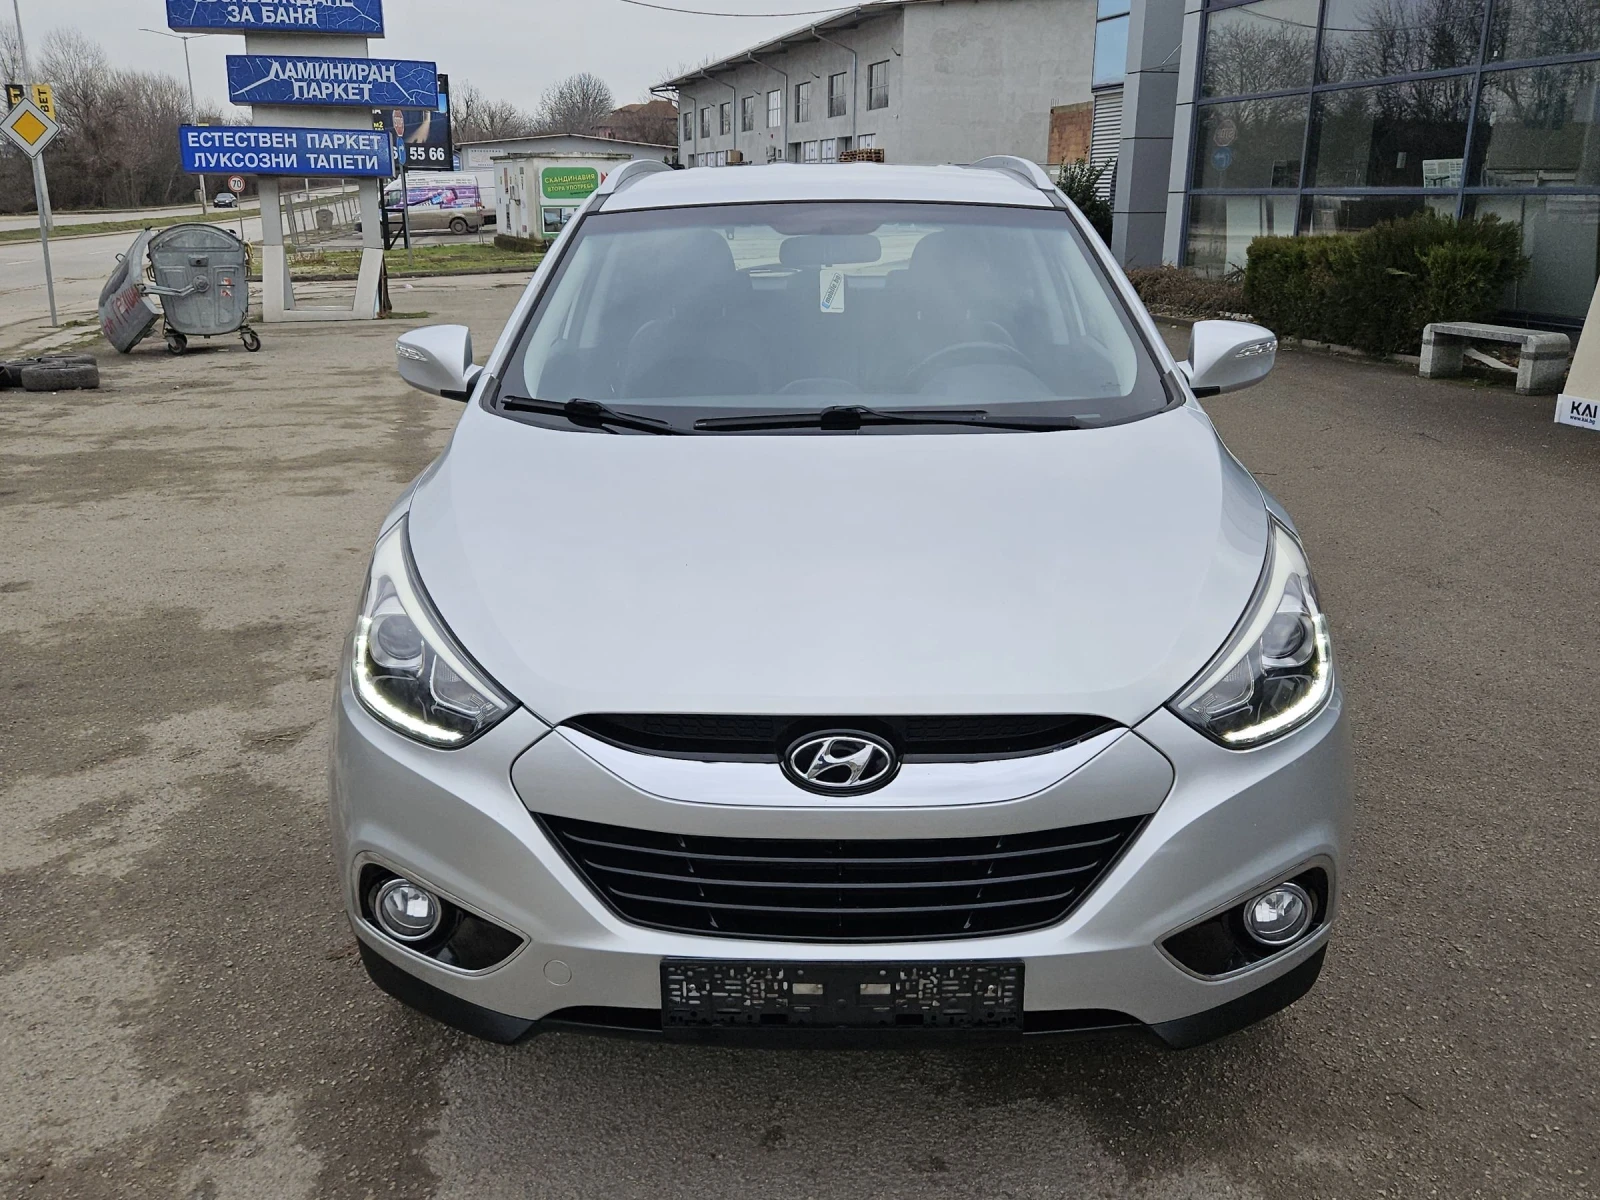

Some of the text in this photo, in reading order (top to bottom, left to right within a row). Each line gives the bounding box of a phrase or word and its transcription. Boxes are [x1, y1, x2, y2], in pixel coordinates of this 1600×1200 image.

[228, 6, 317, 24] ЗА БАНЯ
[271, 62, 396, 82] ЛАМИНИРАН
[294, 82, 373, 100] ПАРКЕТ
[187, 132, 382, 150] ЕСТЕСТВЕН ПАРКЕТ
[194, 153, 379, 170] ЛУКСОЗНИ ТАПЕТИ
[409, 146, 426, 160] 55
[429, 147, 445, 161] 66
[231, 180, 242, 188] 70
[544, 173, 595, 184] СКАНДИНАВИЯ
[547, 185, 565, 193] ВТОРА
[1571, 401, 1598, 418] KAI
